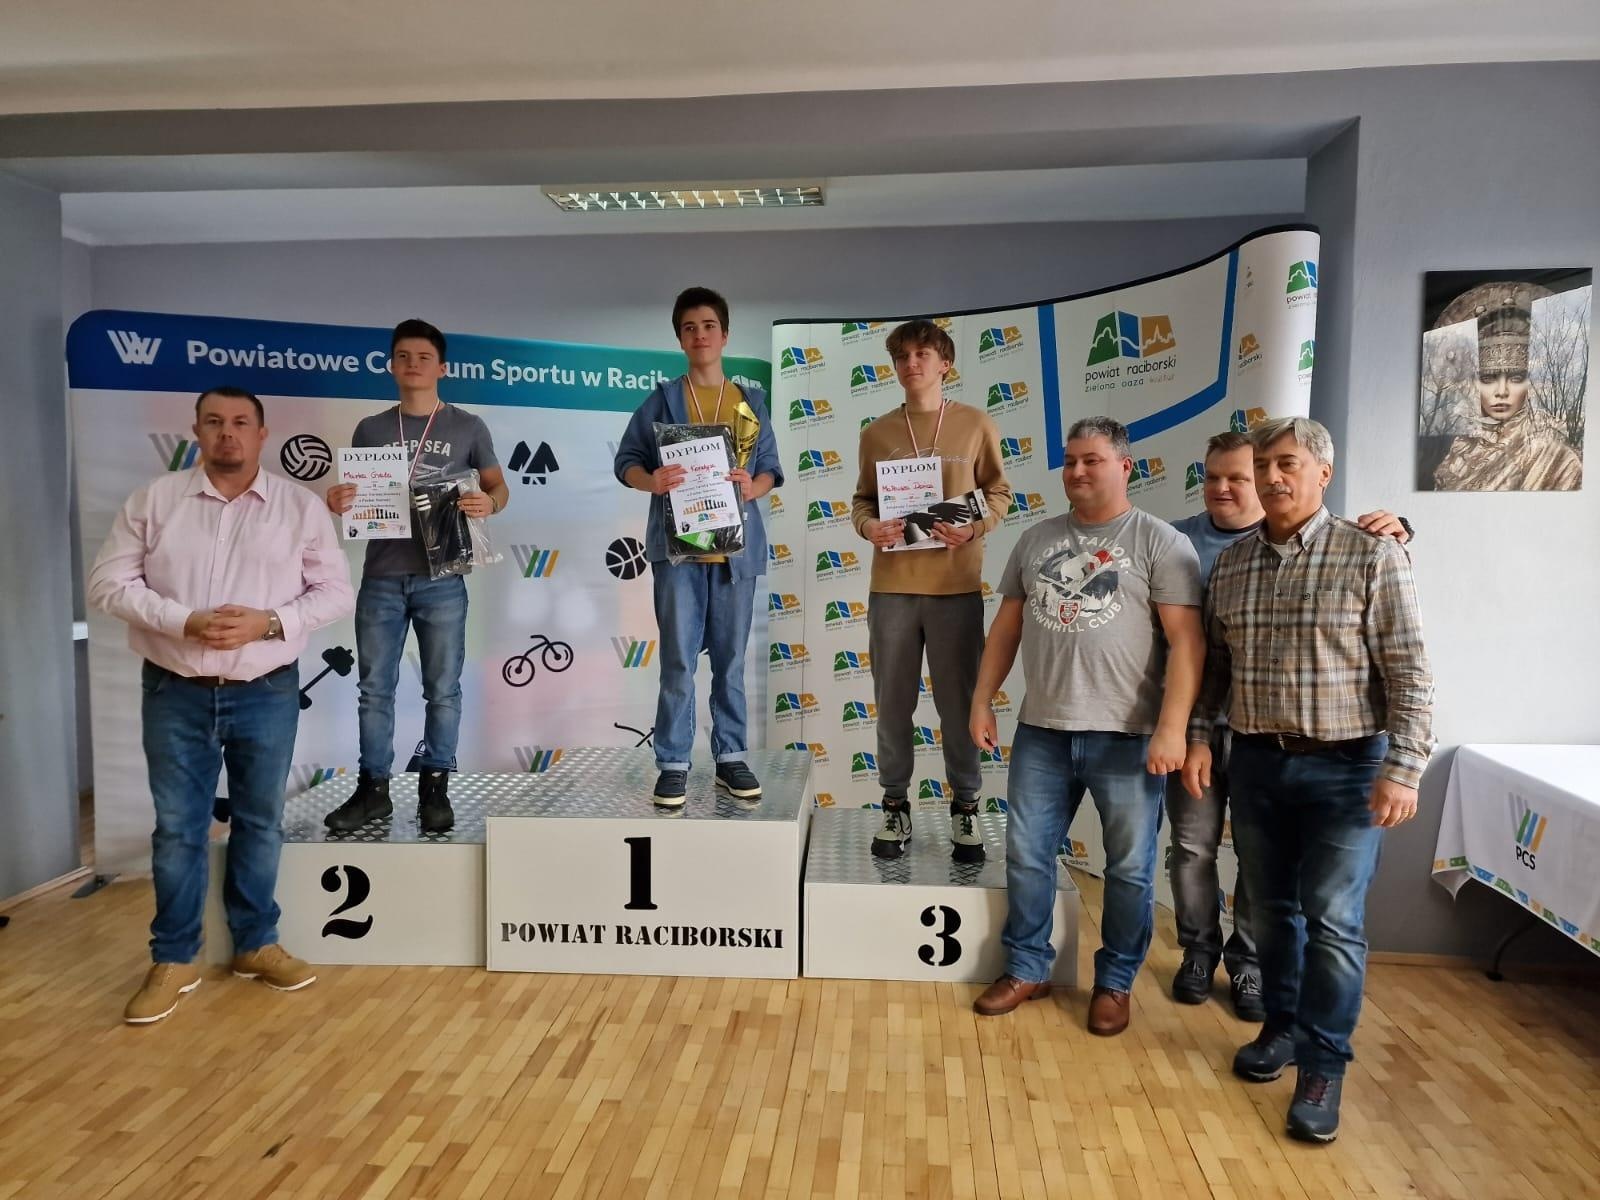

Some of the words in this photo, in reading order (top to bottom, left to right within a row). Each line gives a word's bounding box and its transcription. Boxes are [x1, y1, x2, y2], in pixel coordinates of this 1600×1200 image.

[186, 340, 359, 372] Powiatowe
[492, 358, 575, 386] Sportu
[581, 369, 601, 386] w
[1085, 365, 1120, 384] powiat
[1127, 354, 1176, 375] raciborski
[1122, 378, 1144, 388] oaza
[344, 453, 402, 462] DYPLOM
[424, 440, 451, 456] SEA
[666, 442, 720, 460] DYPLOM
[881, 463, 936, 475] DYPLOM
[1030, 599, 1084, 632] DOWNHILL
[1088, 602, 1122, 629] CLUB
[1516, 846, 1536, 870] PCS
[624, 836, 658, 910] 1
[321, 864, 374, 939] 2
[501, 922, 606, 944] POWIAT
[616, 925, 784, 949] RACIBORSKI
[918, 905, 962, 966] 3
